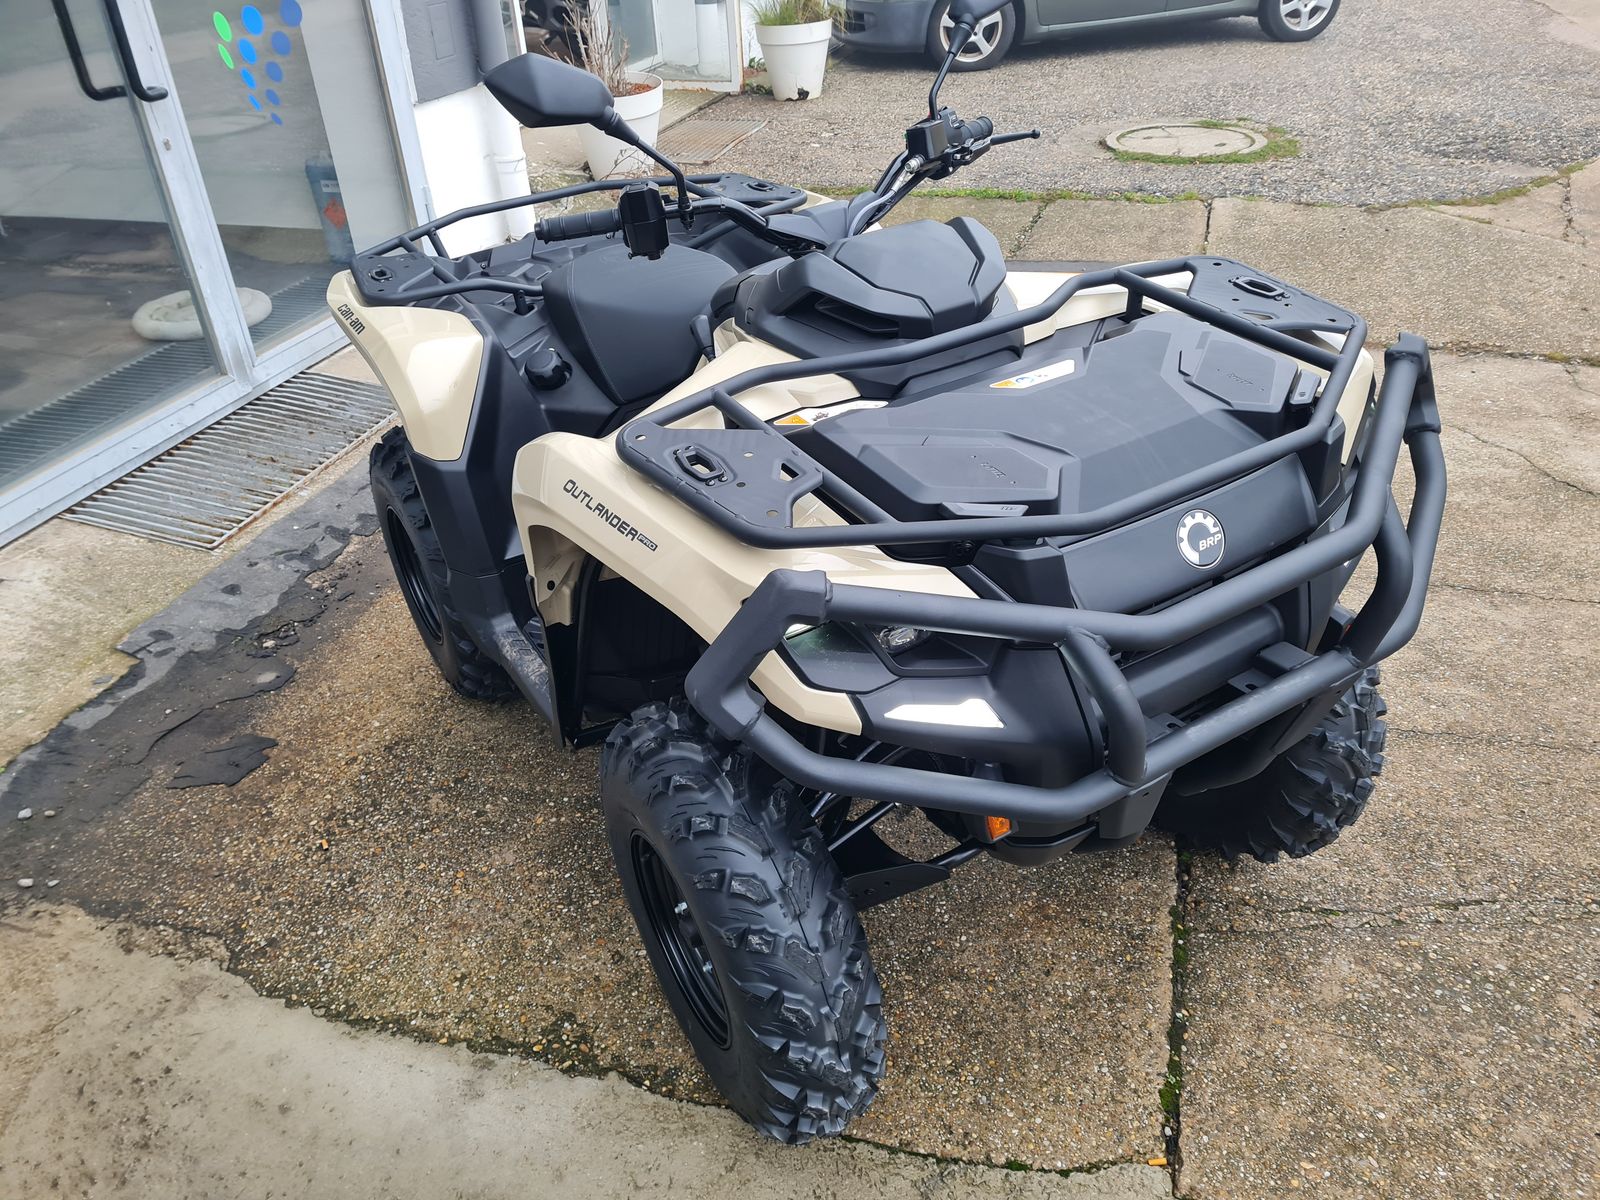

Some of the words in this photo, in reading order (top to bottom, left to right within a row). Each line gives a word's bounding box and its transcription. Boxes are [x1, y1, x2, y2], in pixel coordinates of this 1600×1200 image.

[337, 304, 365, 334] can-am
[563, 479, 638, 541] OUTLANDER
[638, 535, 657, 551] PRO
[1199, 533, 1221, 551] BRP
